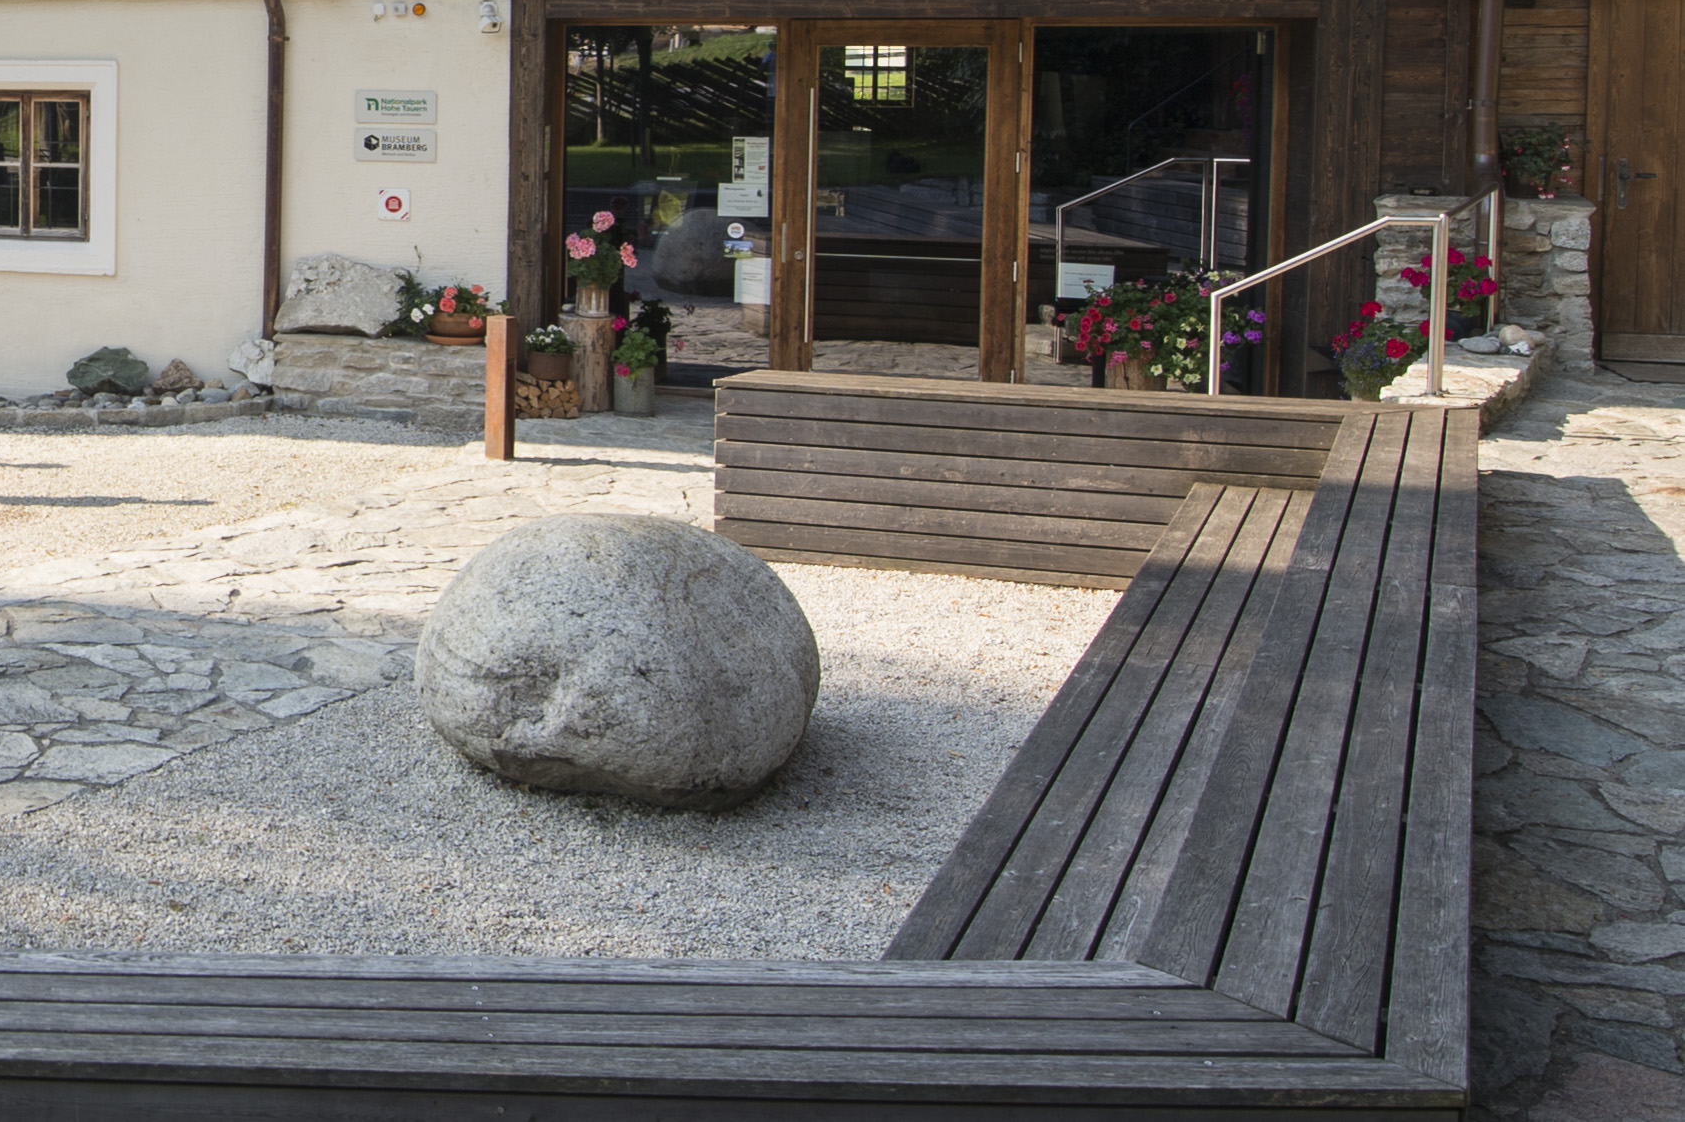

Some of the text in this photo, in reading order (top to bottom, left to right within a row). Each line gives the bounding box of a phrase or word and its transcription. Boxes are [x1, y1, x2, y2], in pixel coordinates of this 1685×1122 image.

[381, 98, 427, 106] Nationalpark
[381, 135, 421, 143] MUSEUM
[381, 143, 428, 151] BRAMBERG
